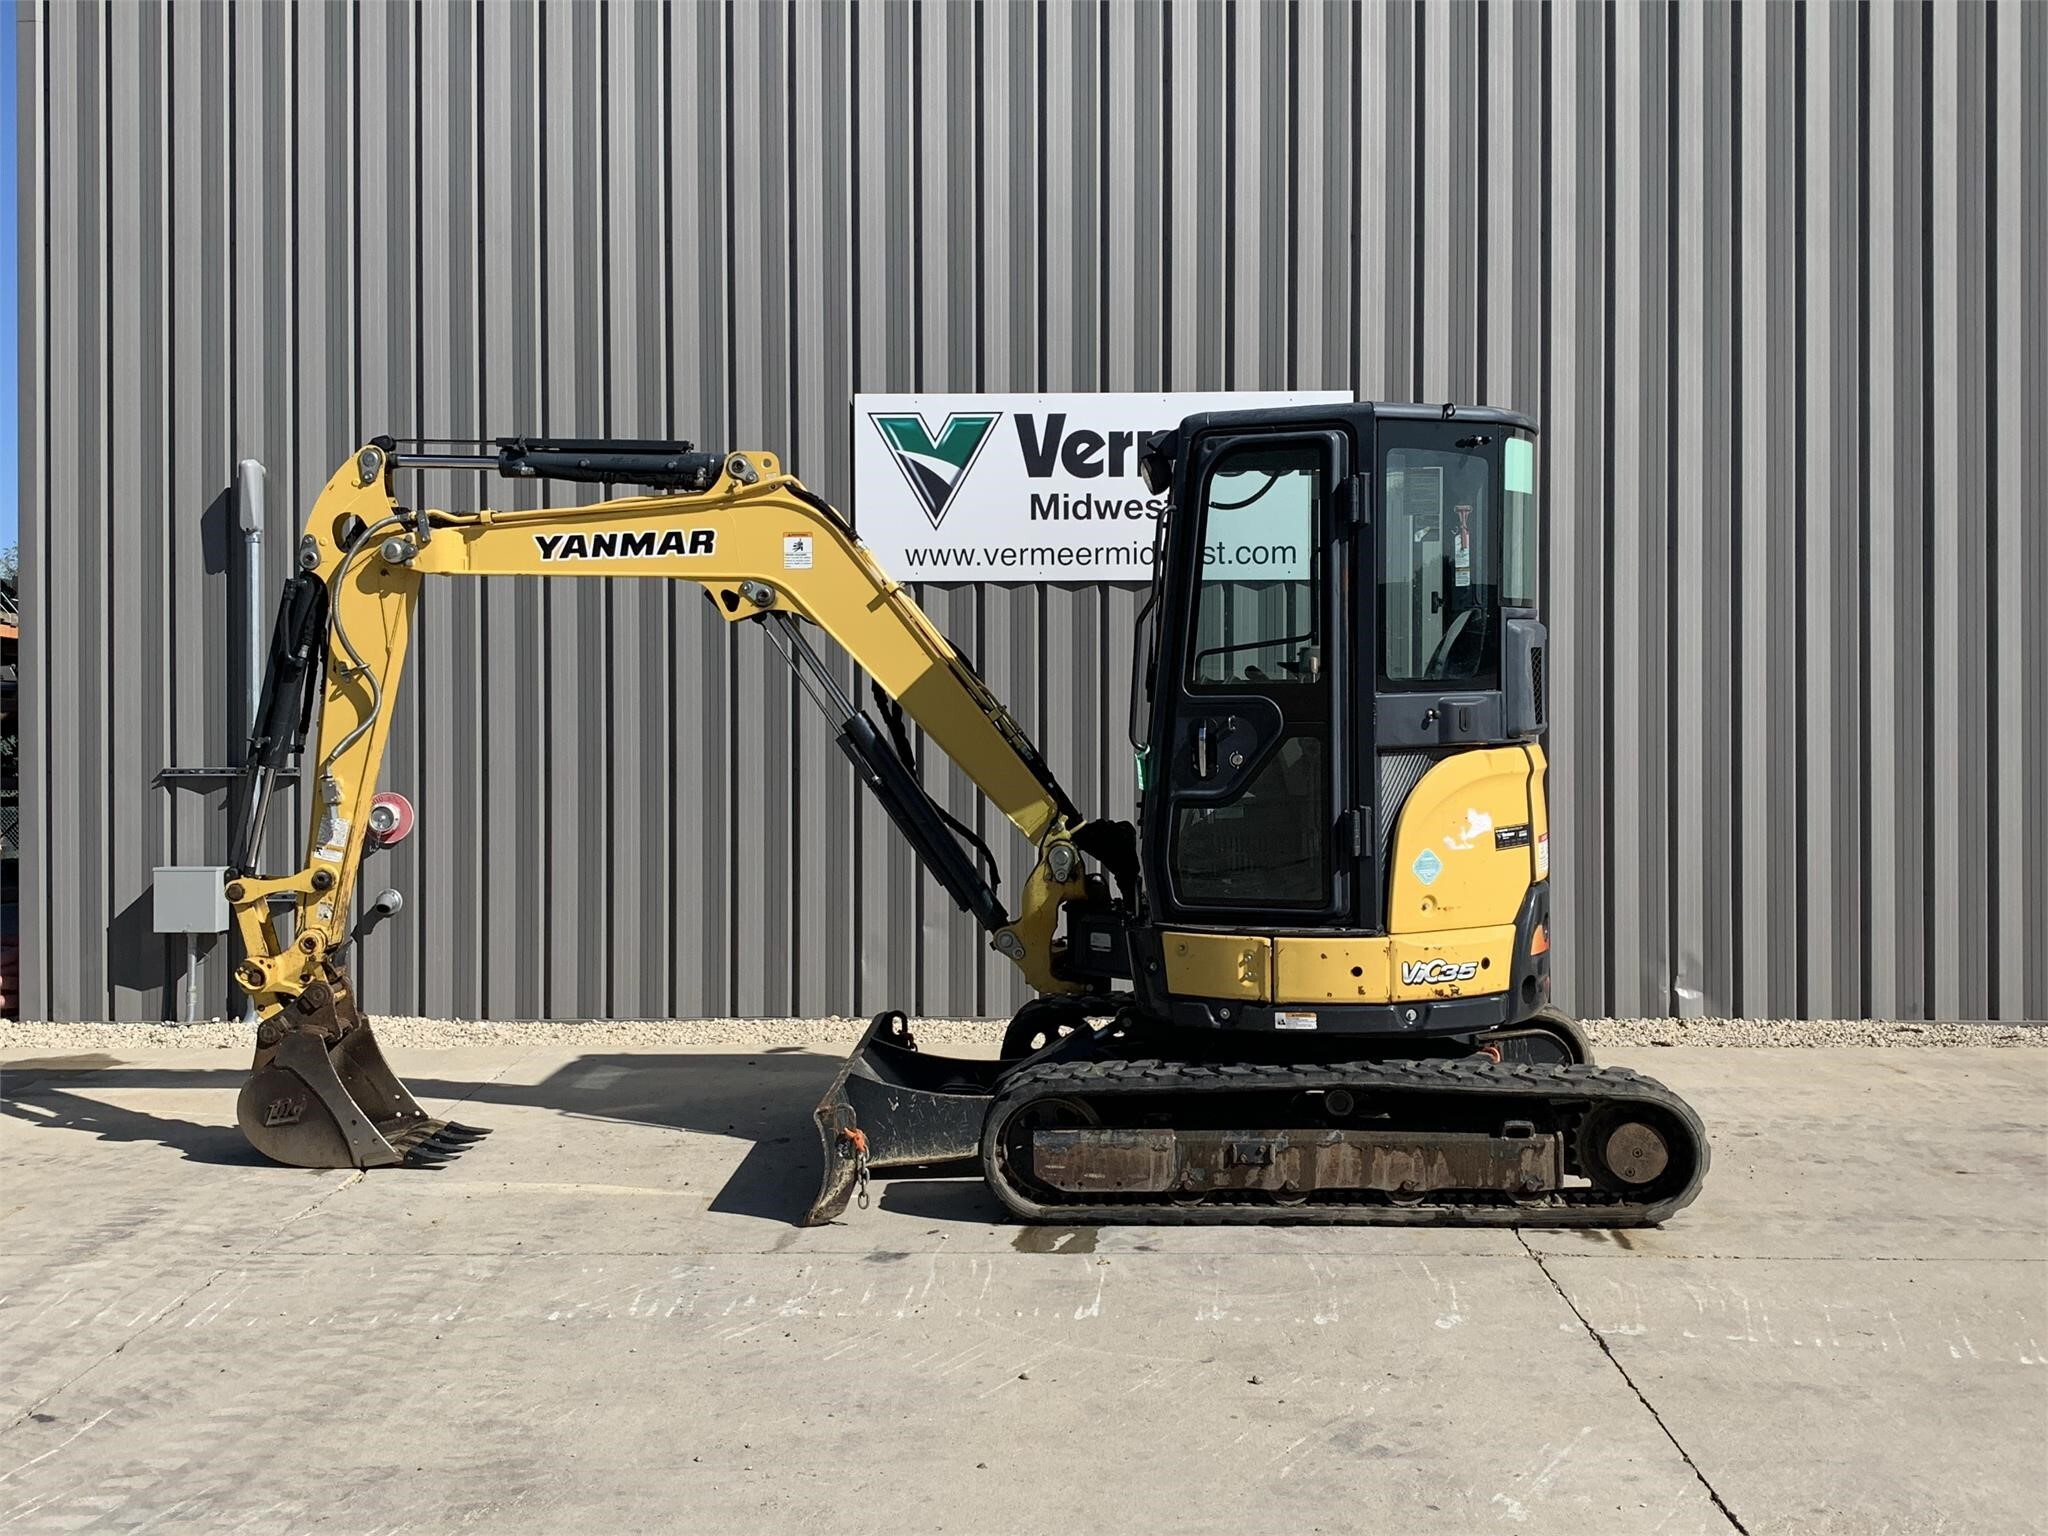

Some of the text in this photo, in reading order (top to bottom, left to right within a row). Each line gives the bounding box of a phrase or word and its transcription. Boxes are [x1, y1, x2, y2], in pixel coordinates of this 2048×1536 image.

[1030, 493, 1168, 520] Midwes
[534, 529, 716, 560] YANMAR
[905, 540, 1298, 567] www.vermeermidst.com
